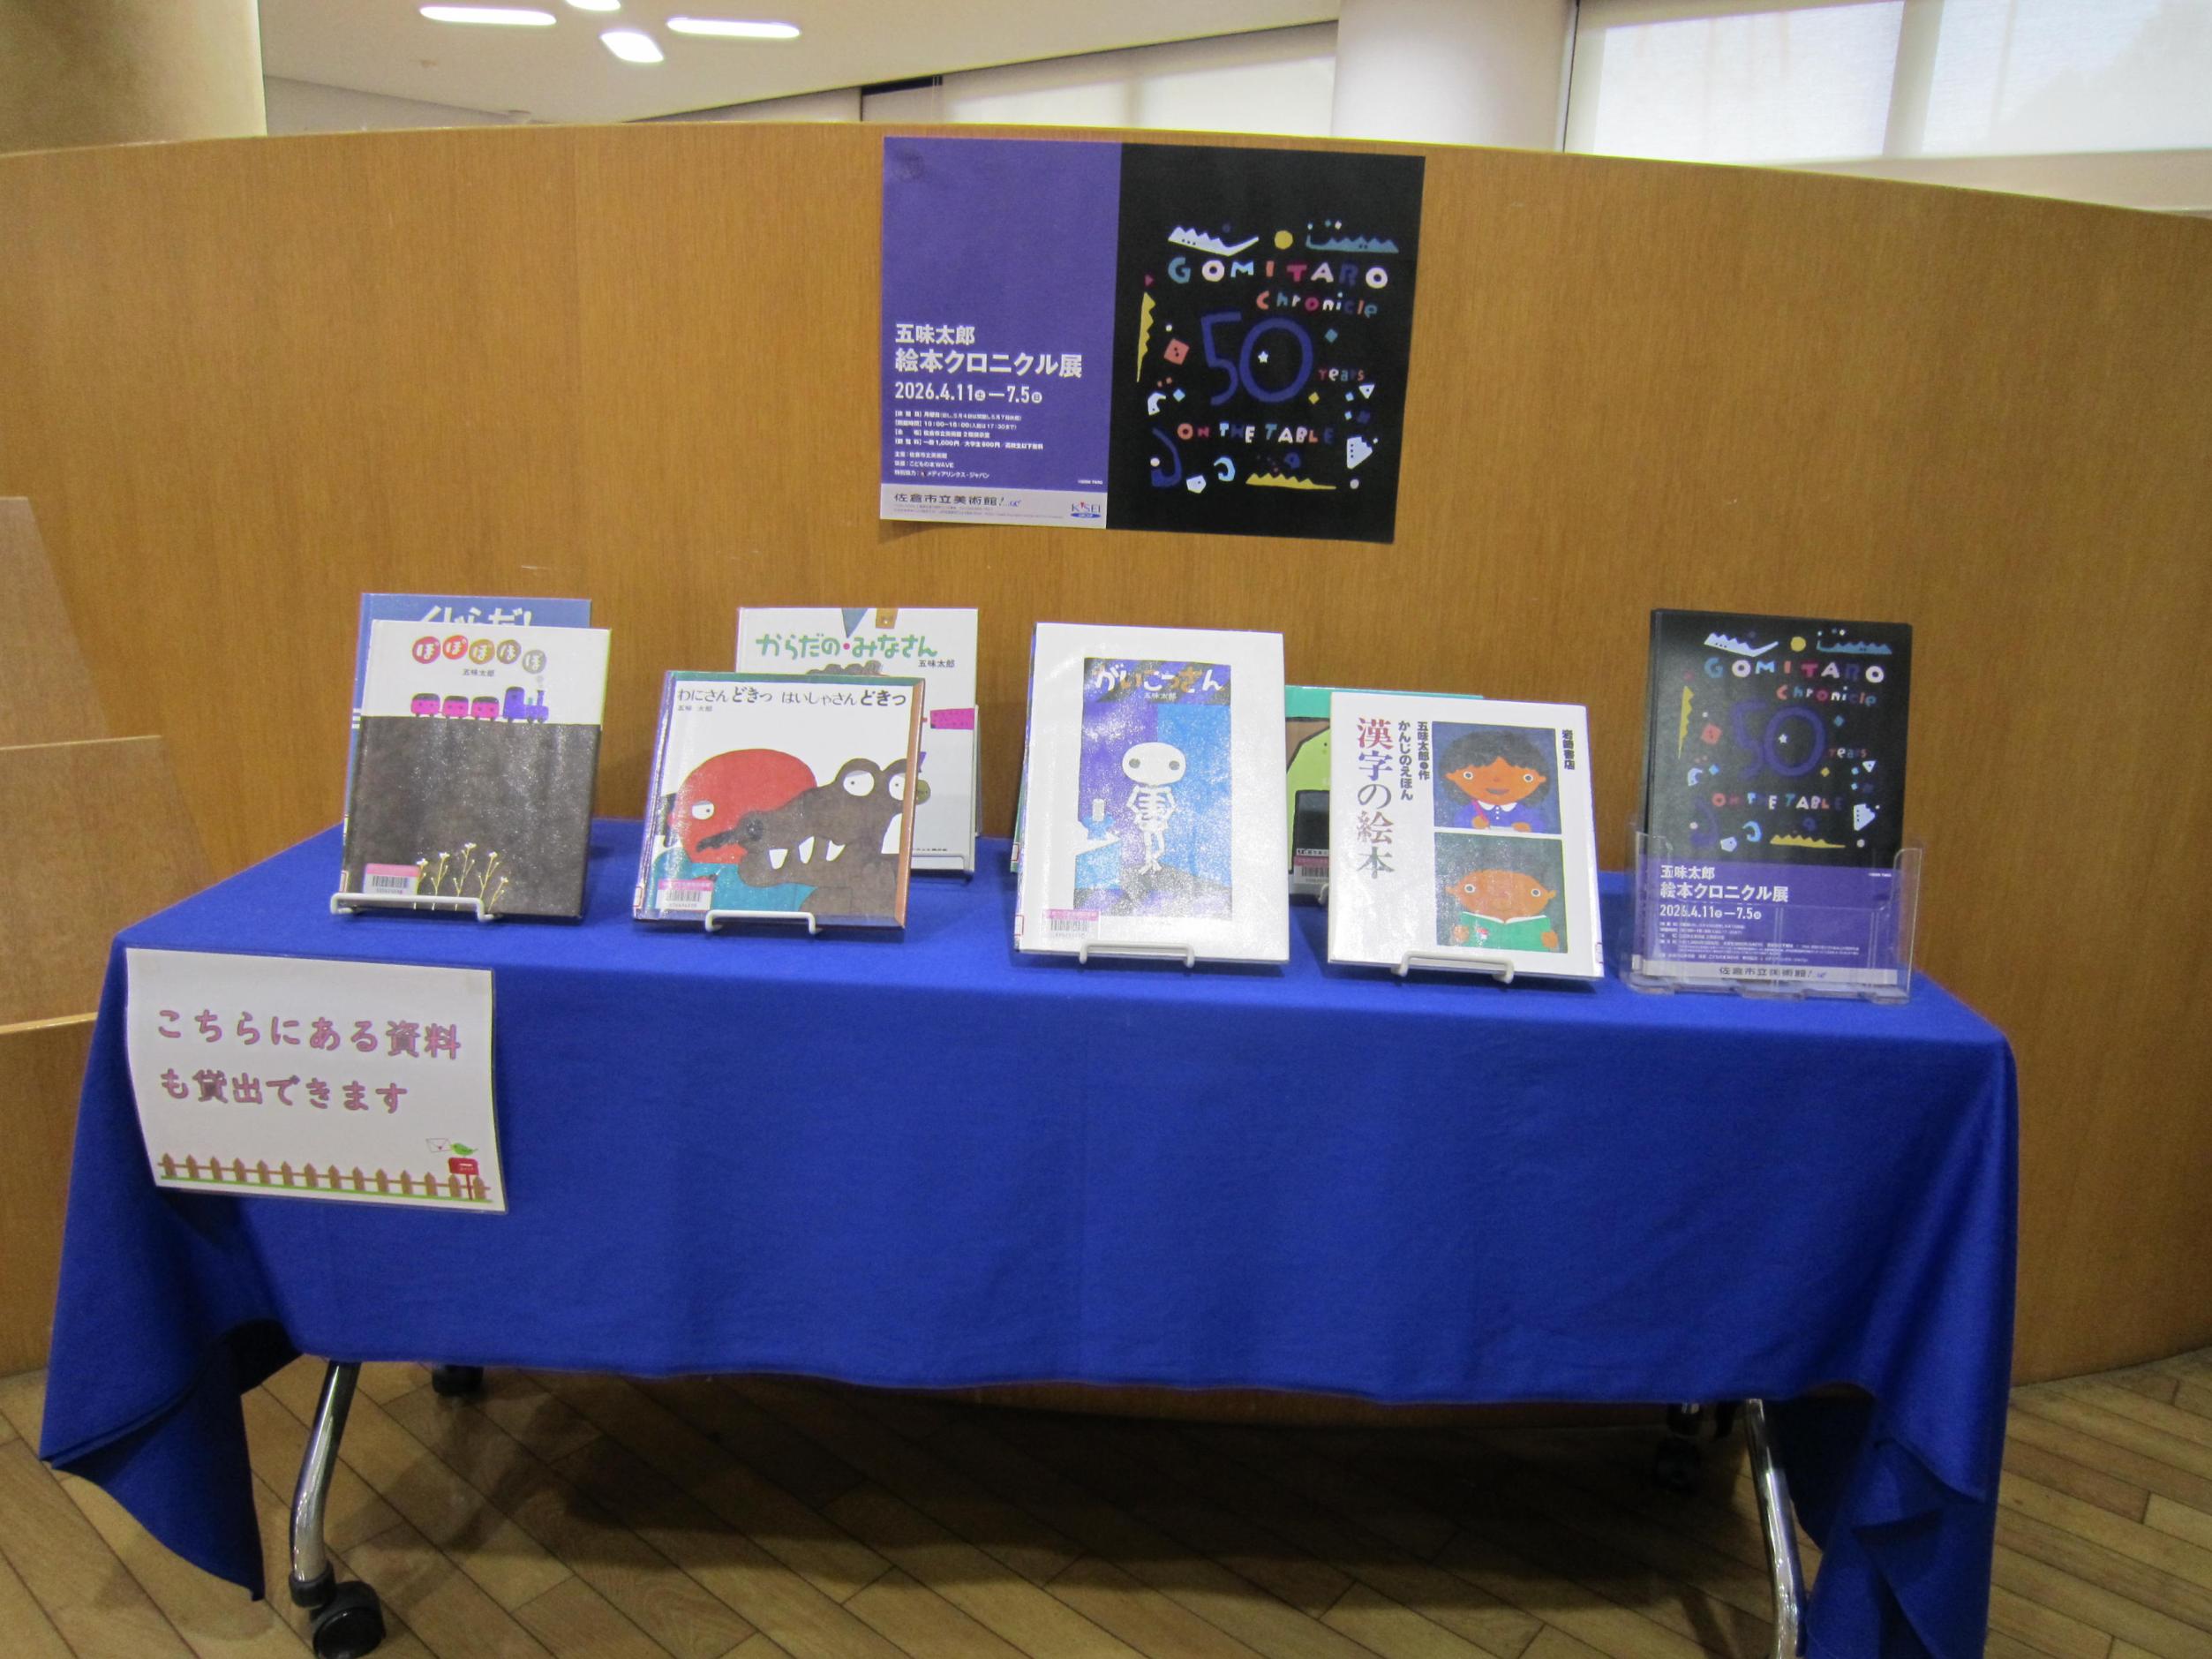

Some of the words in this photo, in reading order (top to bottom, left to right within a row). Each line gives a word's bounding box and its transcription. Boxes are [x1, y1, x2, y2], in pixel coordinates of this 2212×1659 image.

[1256, 290, 1378, 318] Chronicle
[895, 323, 975, 345] 五味太郎
[895, 348, 1082, 378] 絵本クロニクル展
[1200, 312, 1313, 406] 50
[1177, 423, 1209, 441] ON
[1219, 421, 1256, 443] THE
[1265, 424, 1334, 443] TABLE
[463, 668, 494, 677] 五味太郎
[918, 660, 956, 668] 五味太郎
[1144, 692, 1177, 701] 五味太郎
[1732, 698, 1826, 780] 50
[1398, 720, 1413, 801] かんじのえほん
[1357, 717, 1395, 879] 漢字の絵本
[1660, 864, 1715, 880] 五味太郎
[1660, 882, 1789, 902] 絵本クロニクル展
[158, 1008, 461, 1059] こちらにある資料
[161, 1068, 408, 1113] も貸出できます
